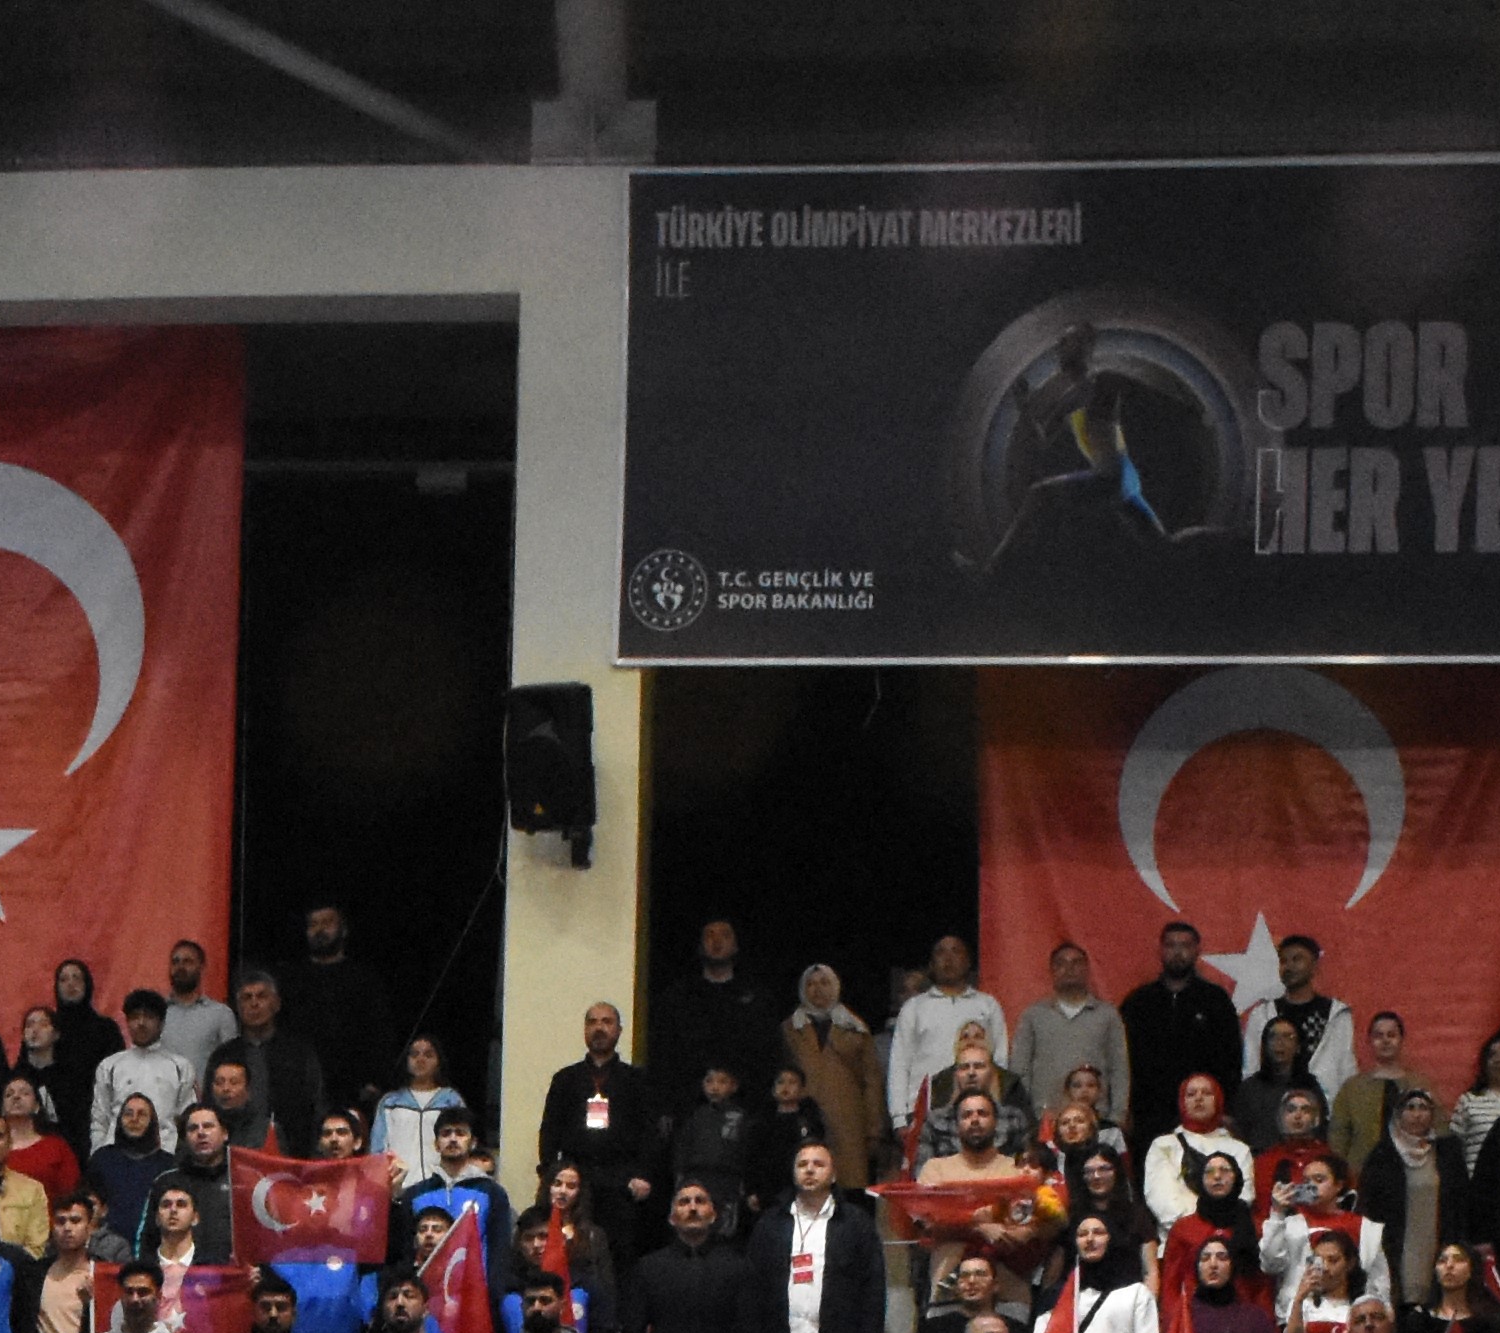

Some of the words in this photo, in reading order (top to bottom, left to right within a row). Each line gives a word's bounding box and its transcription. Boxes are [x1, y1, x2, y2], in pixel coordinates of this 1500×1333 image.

[656, 205, 763, 248] TÜRKİYE
[771, 204, 913, 247] OLİMPİYAT
[919, 202, 1082, 246] MERKEZLERİ
[655, 255, 691, 298] İLE
[1257, 320, 1469, 431] SPOR
[1254, 445, 1401, 555] HER
[717, 570, 752, 588] T.C.
[758, 567, 844, 590] GENÇLİK
[849, 570, 875, 588] VE
[717, 592, 767, 610] SPOR
[771, 590, 875, 610] BAKANLIĞI
